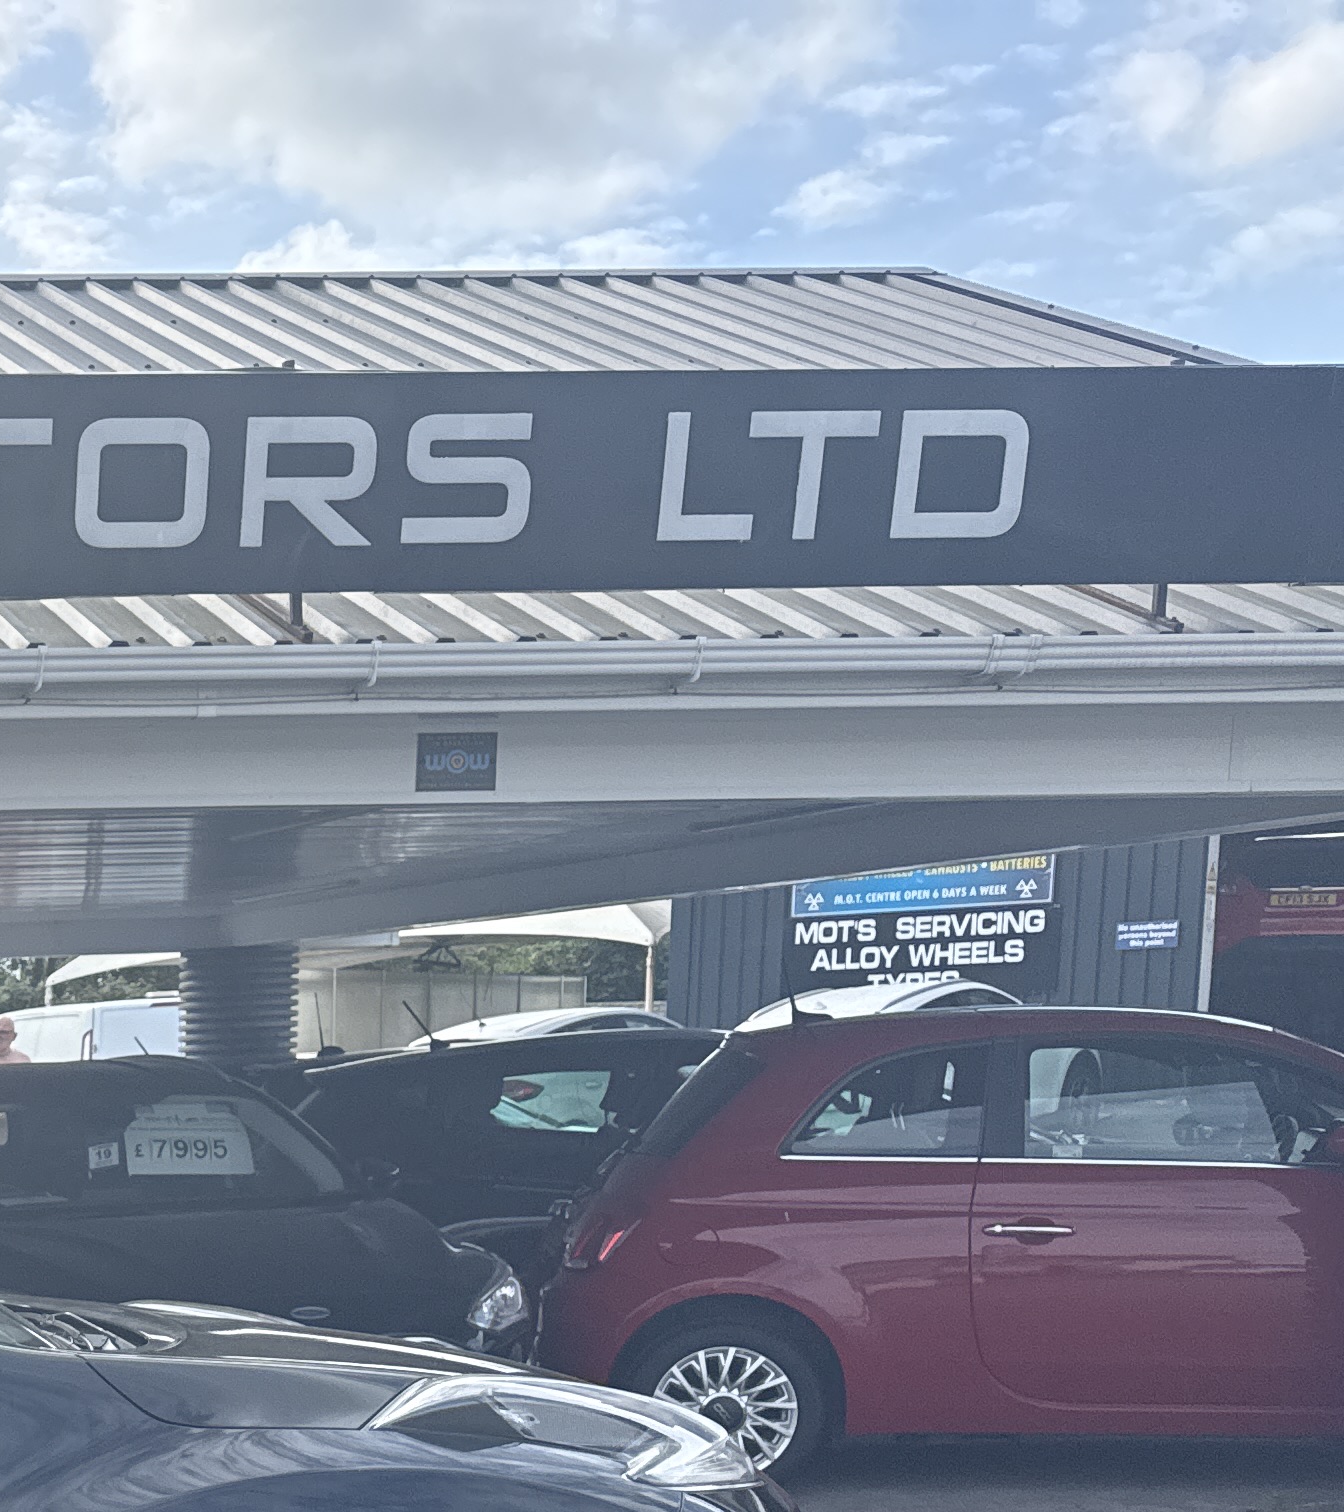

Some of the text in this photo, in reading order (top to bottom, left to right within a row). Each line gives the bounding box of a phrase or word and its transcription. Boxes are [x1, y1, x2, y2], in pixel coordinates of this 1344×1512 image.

[654, 407, 1030, 543] LTD
[990, 855, 1047, 871] BATTERIES
[834, 883, 1007, 905] M.O.T. CENTRE OPEN 6 DAYS A WEEK
[794, 908, 1046, 945] MOT'S SERVICING
[810, 939, 1025, 971] ALLOY WHEELS
